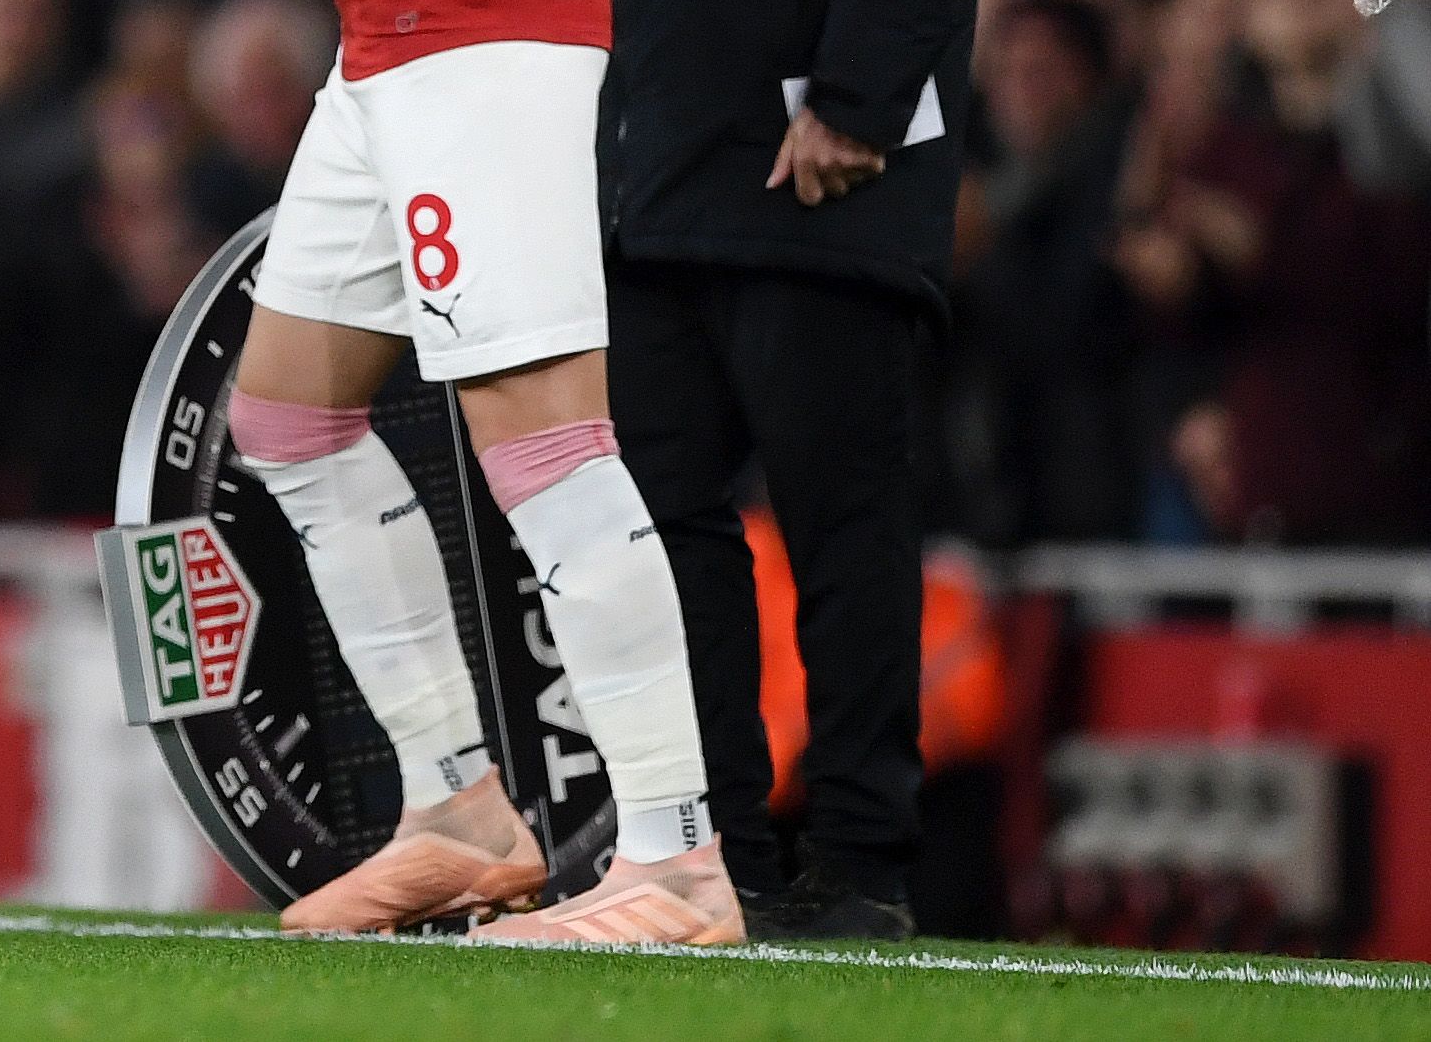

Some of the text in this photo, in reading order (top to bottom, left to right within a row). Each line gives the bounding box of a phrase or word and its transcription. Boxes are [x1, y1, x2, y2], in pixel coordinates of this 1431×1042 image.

[407, 193, 459, 291] 8
[165, 395, 206, 471] 05
[142, 544, 194, 699] TAG
[185, 534, 247, 693] HEUER
[215, 757, 268, 828] 55
